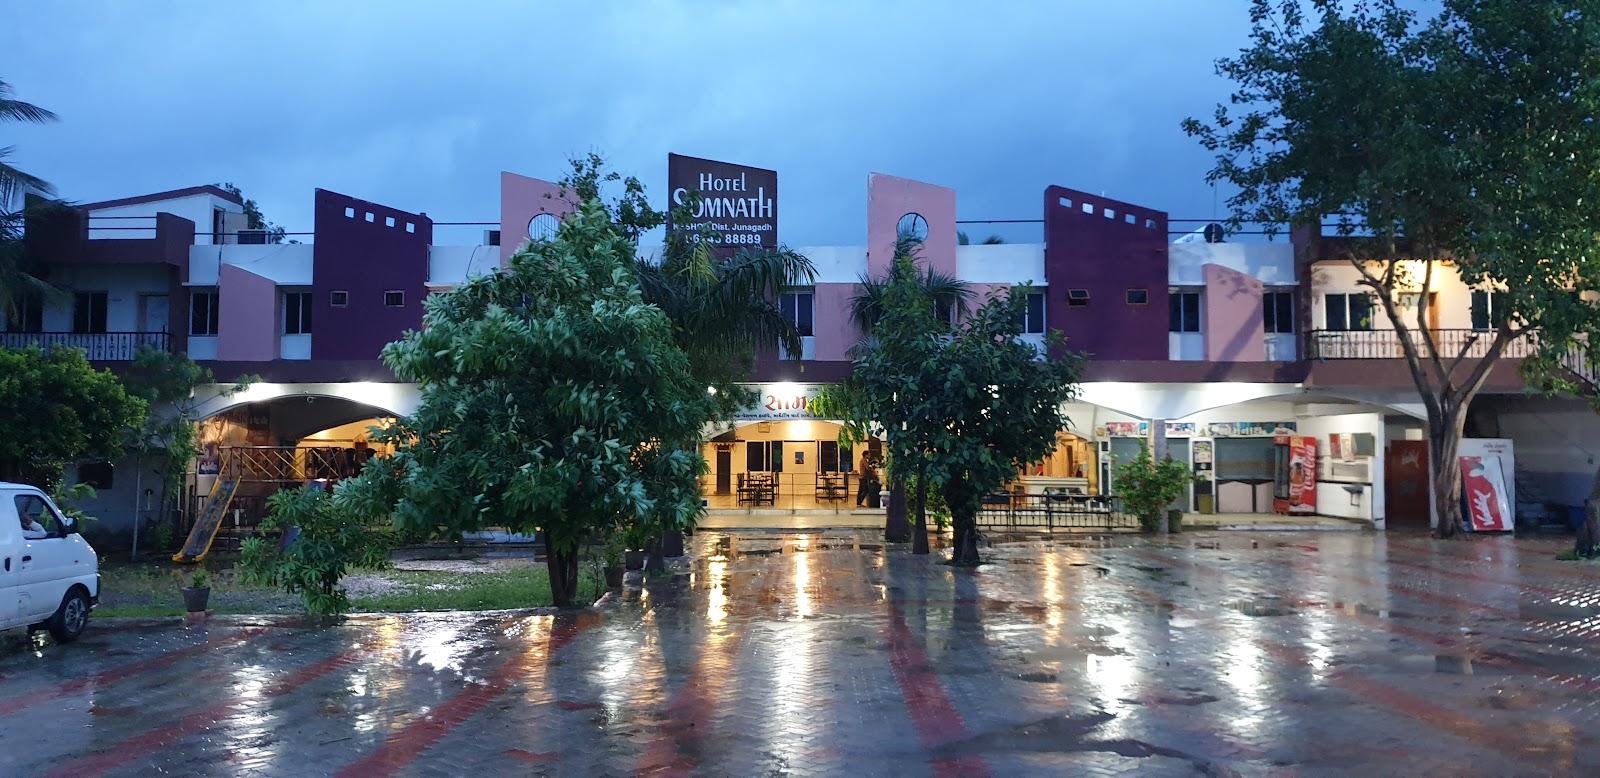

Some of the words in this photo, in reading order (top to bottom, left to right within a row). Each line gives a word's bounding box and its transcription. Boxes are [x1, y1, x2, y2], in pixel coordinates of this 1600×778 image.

[700, 172, 746, 191] HOTEL
[712, 223, 730, 231] Dist.
[732, 223, 772, 233] Junagadh
[725, 234, 761, 244] 88889
